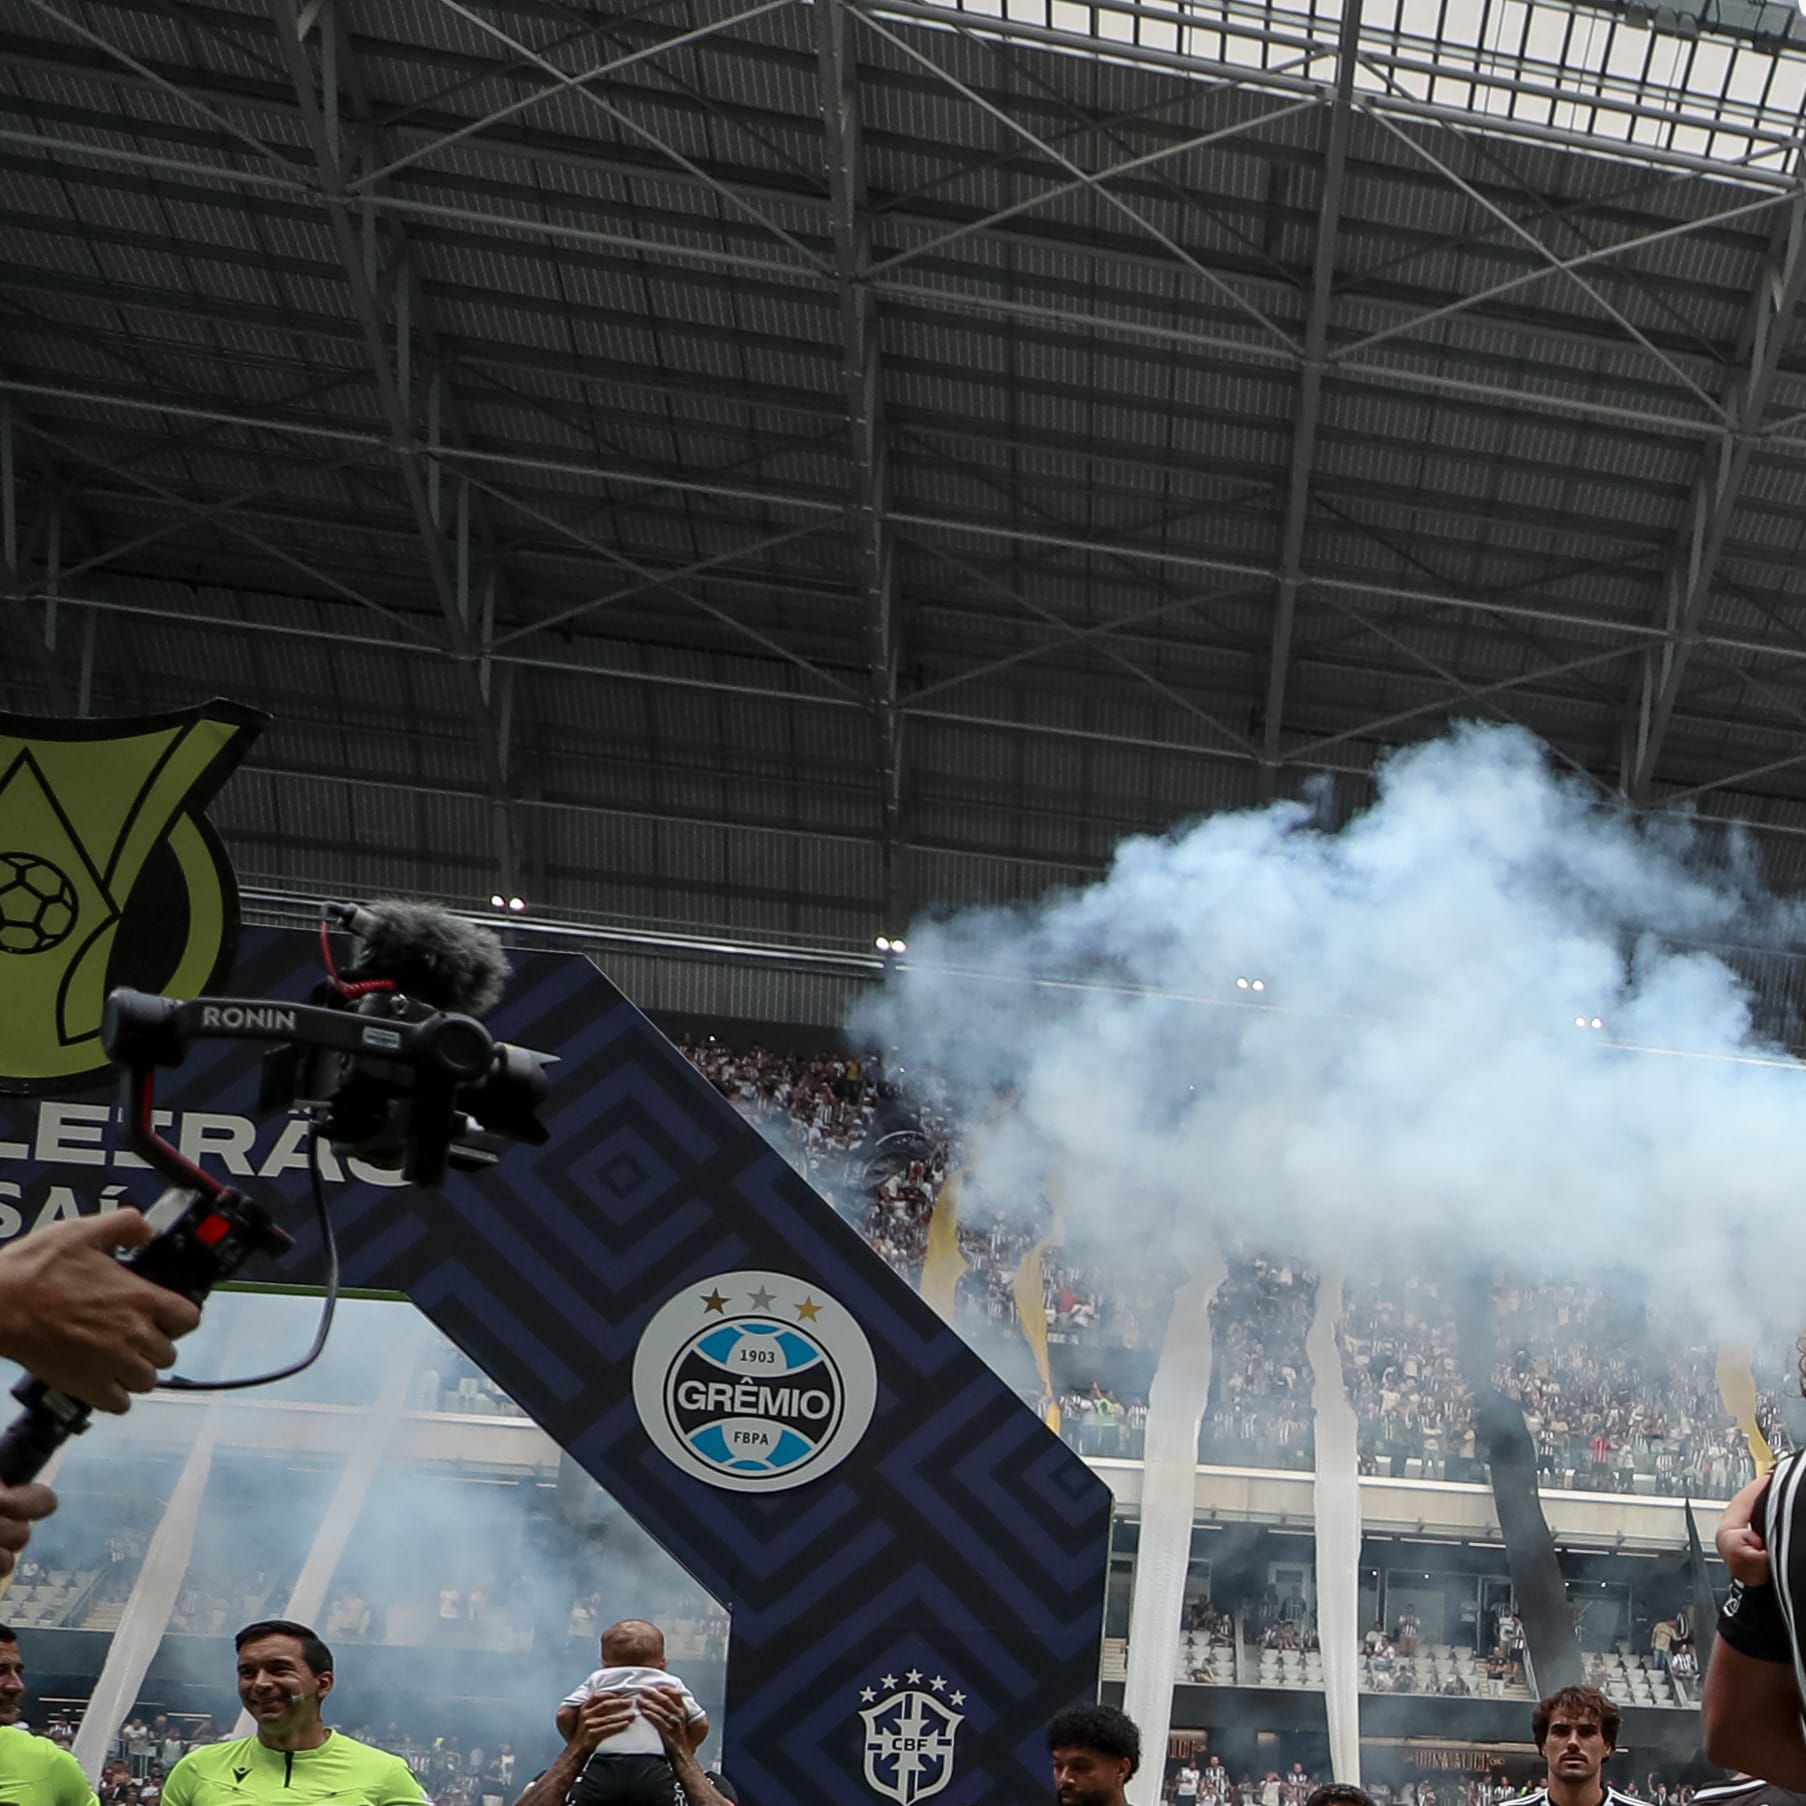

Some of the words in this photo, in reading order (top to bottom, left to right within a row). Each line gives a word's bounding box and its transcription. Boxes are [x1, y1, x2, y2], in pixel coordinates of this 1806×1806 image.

[203, 1008, 296, 1030] RONIN
[740, 1350, 775, 1363] 1903
[677, 1376, 831, 1420] GRÊMIO
[733, 1432, 769, 1445] FBPA
[892, 1738, 928, 1751] CBF
